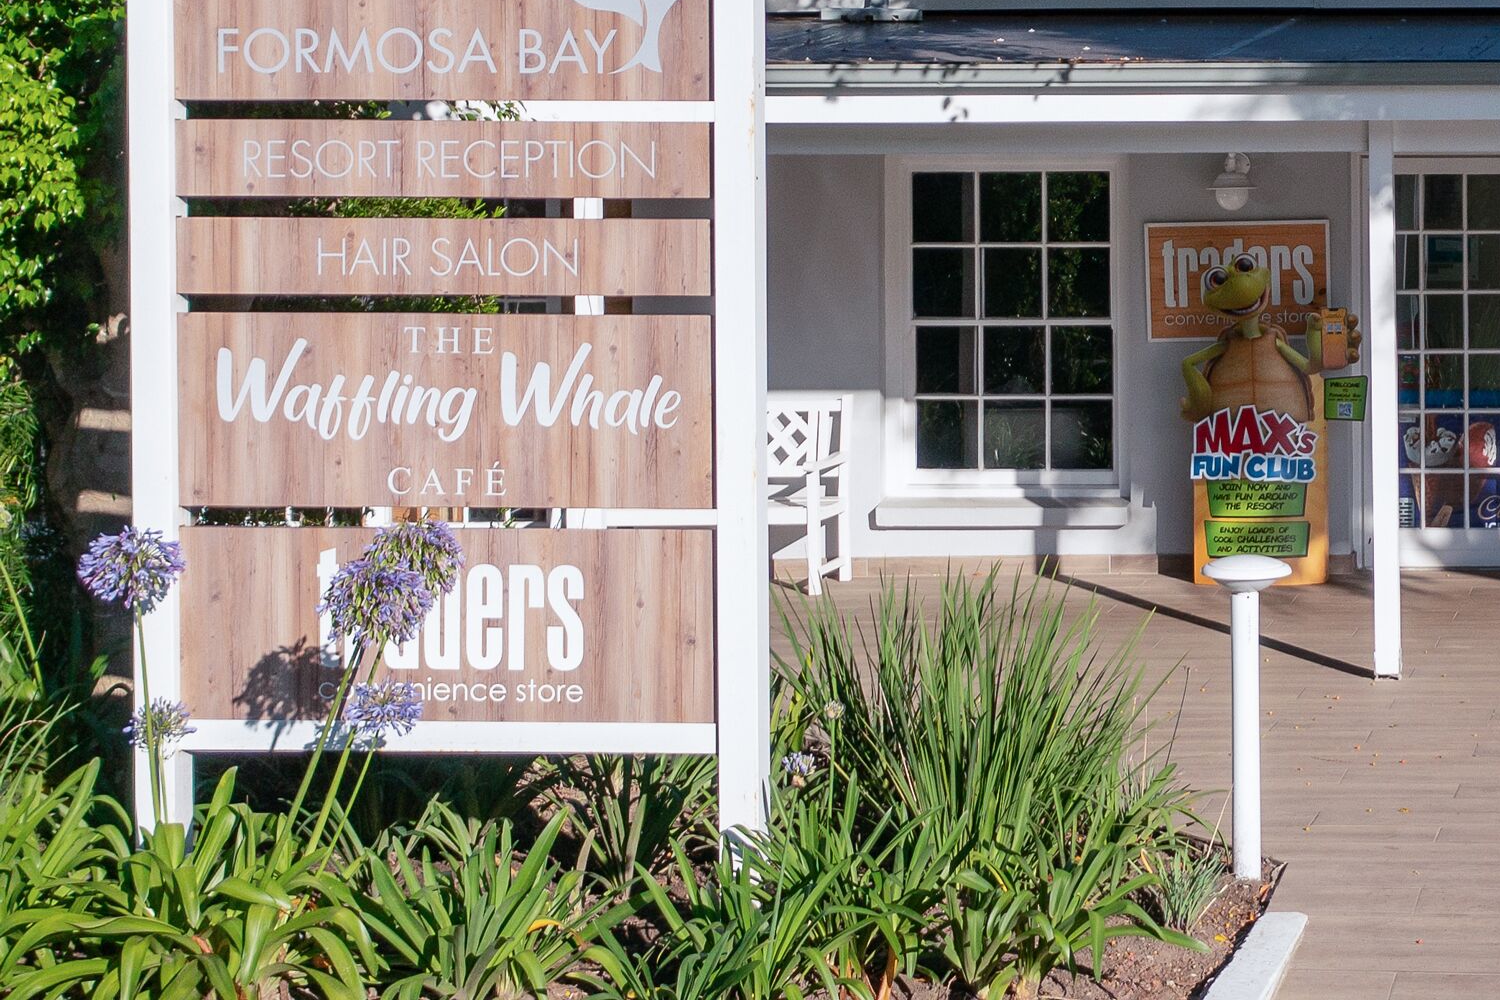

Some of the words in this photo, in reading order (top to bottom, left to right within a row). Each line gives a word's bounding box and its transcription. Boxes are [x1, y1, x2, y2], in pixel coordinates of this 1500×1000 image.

[217, 26, 496, 75] FORMOSA
[519, 27, 618, 75] BAY
[242, 139, 400, 180] RESORT
[417, 139, 657, 180] RECEPTION
[317, 237, 413, 277] HAIR
[430, 237, 580, 278] SALON
[403, 326, 495, 355] THE
[216, 337, 478, 442] Waffling
[500, 342, 682, 435] Whale
[386, 460, 508, 498] CAFÉ
[1191, 453, 1242, 480] FUN
[1245, 454, 1317, 482] CLUB
[1235, 492, 1253, 500] FUN
[1258, 492, 1298, 500] AROUND
[1247, 483, 1270, 491] NOW
[1225, 502, 1241, 510] THE
[1246, 502, 1285, 510] RESORT
[1219, 526, 1244, 534] ENJOY
[1237, 535, 1297, 543] CHALLENGES
[1236, 545, 1293, 553] ACTIVITIES
[317, 547, 585, 672] tders
[515, 678, 585, 703] store
